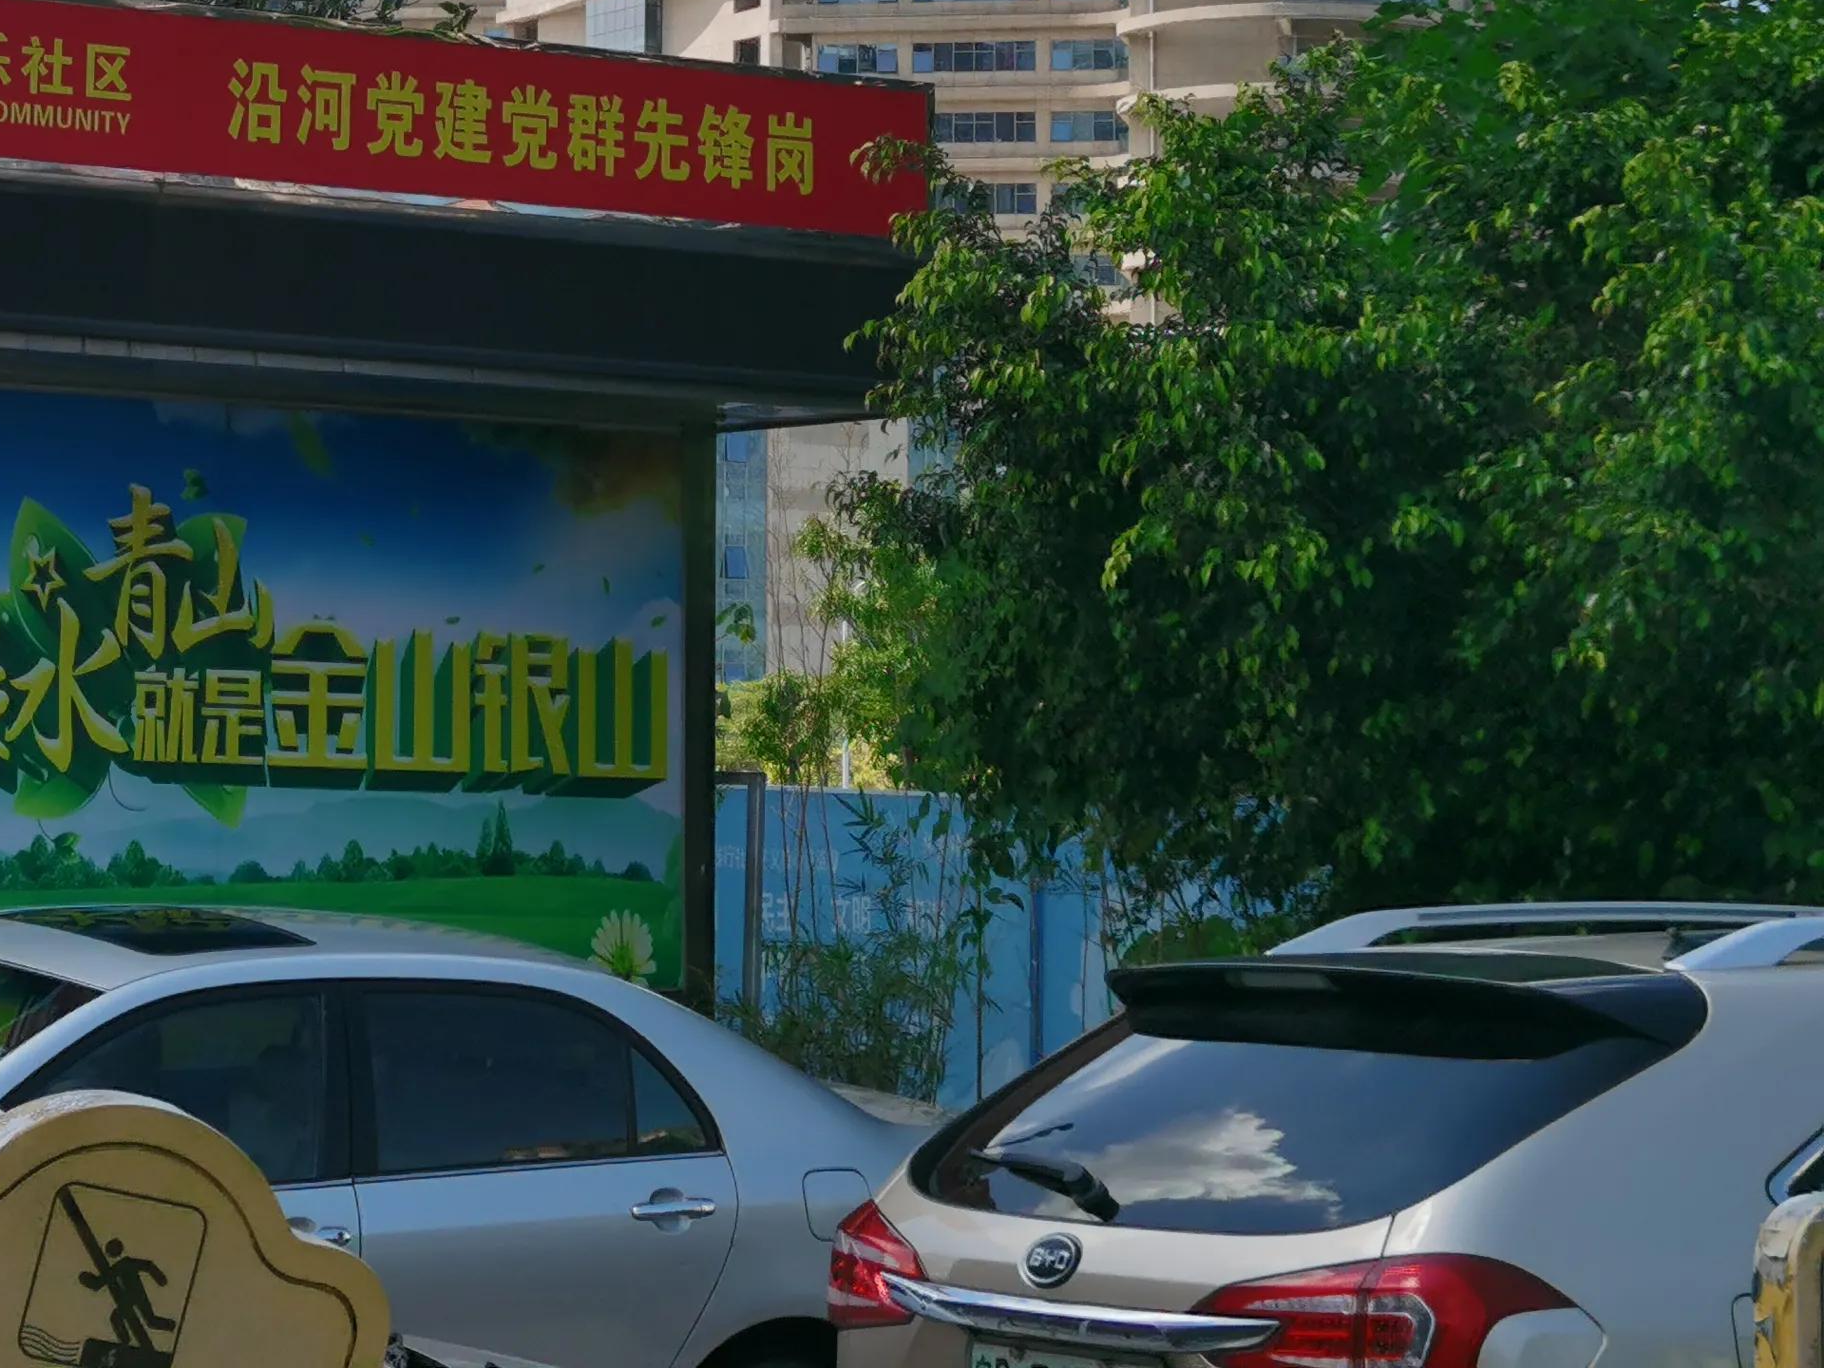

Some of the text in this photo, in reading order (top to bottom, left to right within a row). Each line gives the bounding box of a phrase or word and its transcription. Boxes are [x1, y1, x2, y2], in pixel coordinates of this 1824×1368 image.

[227, 58, 814, 195] 沿河党建党群先锋岗
[84, 482, 274, 658] 青山
[133, 618, 668, 781] 就是金山银山
[1030, 1247, 1071, 1270] BYD
